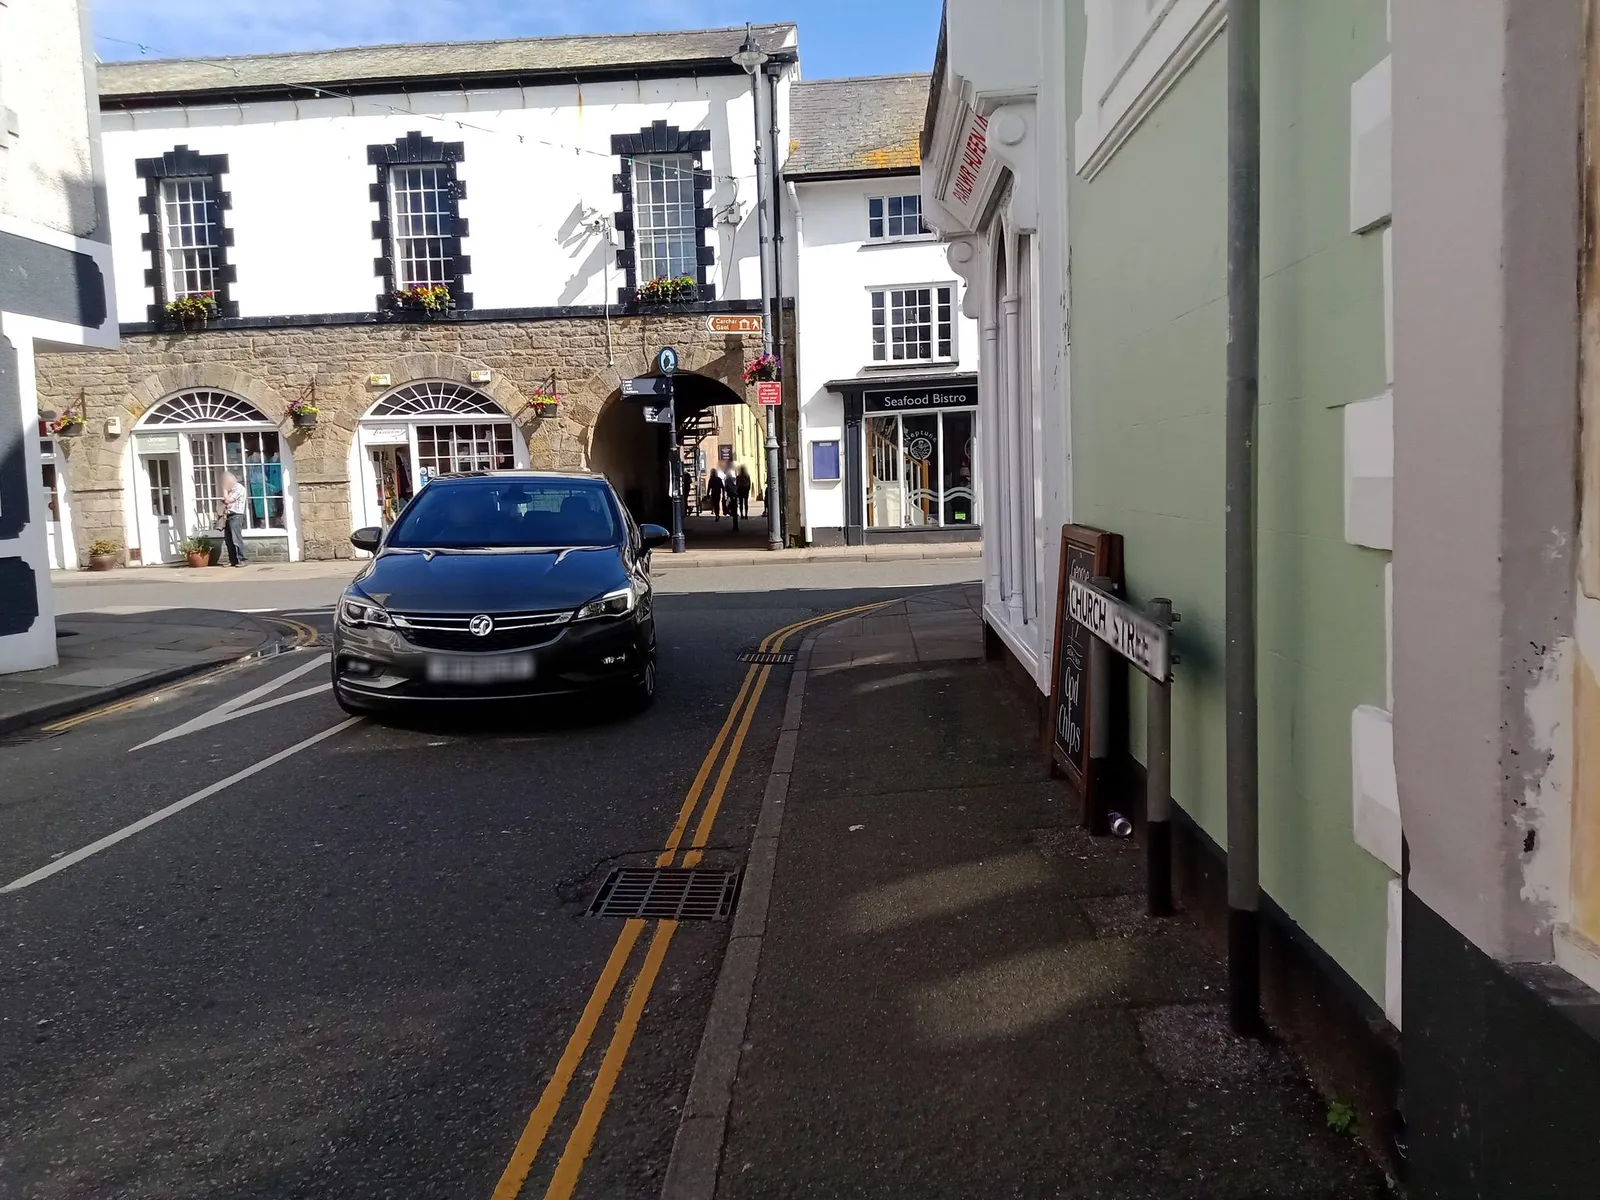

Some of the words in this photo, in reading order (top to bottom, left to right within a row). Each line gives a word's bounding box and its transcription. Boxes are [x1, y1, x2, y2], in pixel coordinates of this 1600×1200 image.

[962, 127, 988, 173] HUFEN
[952, 165, 978, 206] PARLWR
[884, 394, 929, 407] Seafood
[932, 393, 967, 404] Bistro
[904, 430, 937, 443] Neptune
[1070, 586, 1107, 634] CHURCH
